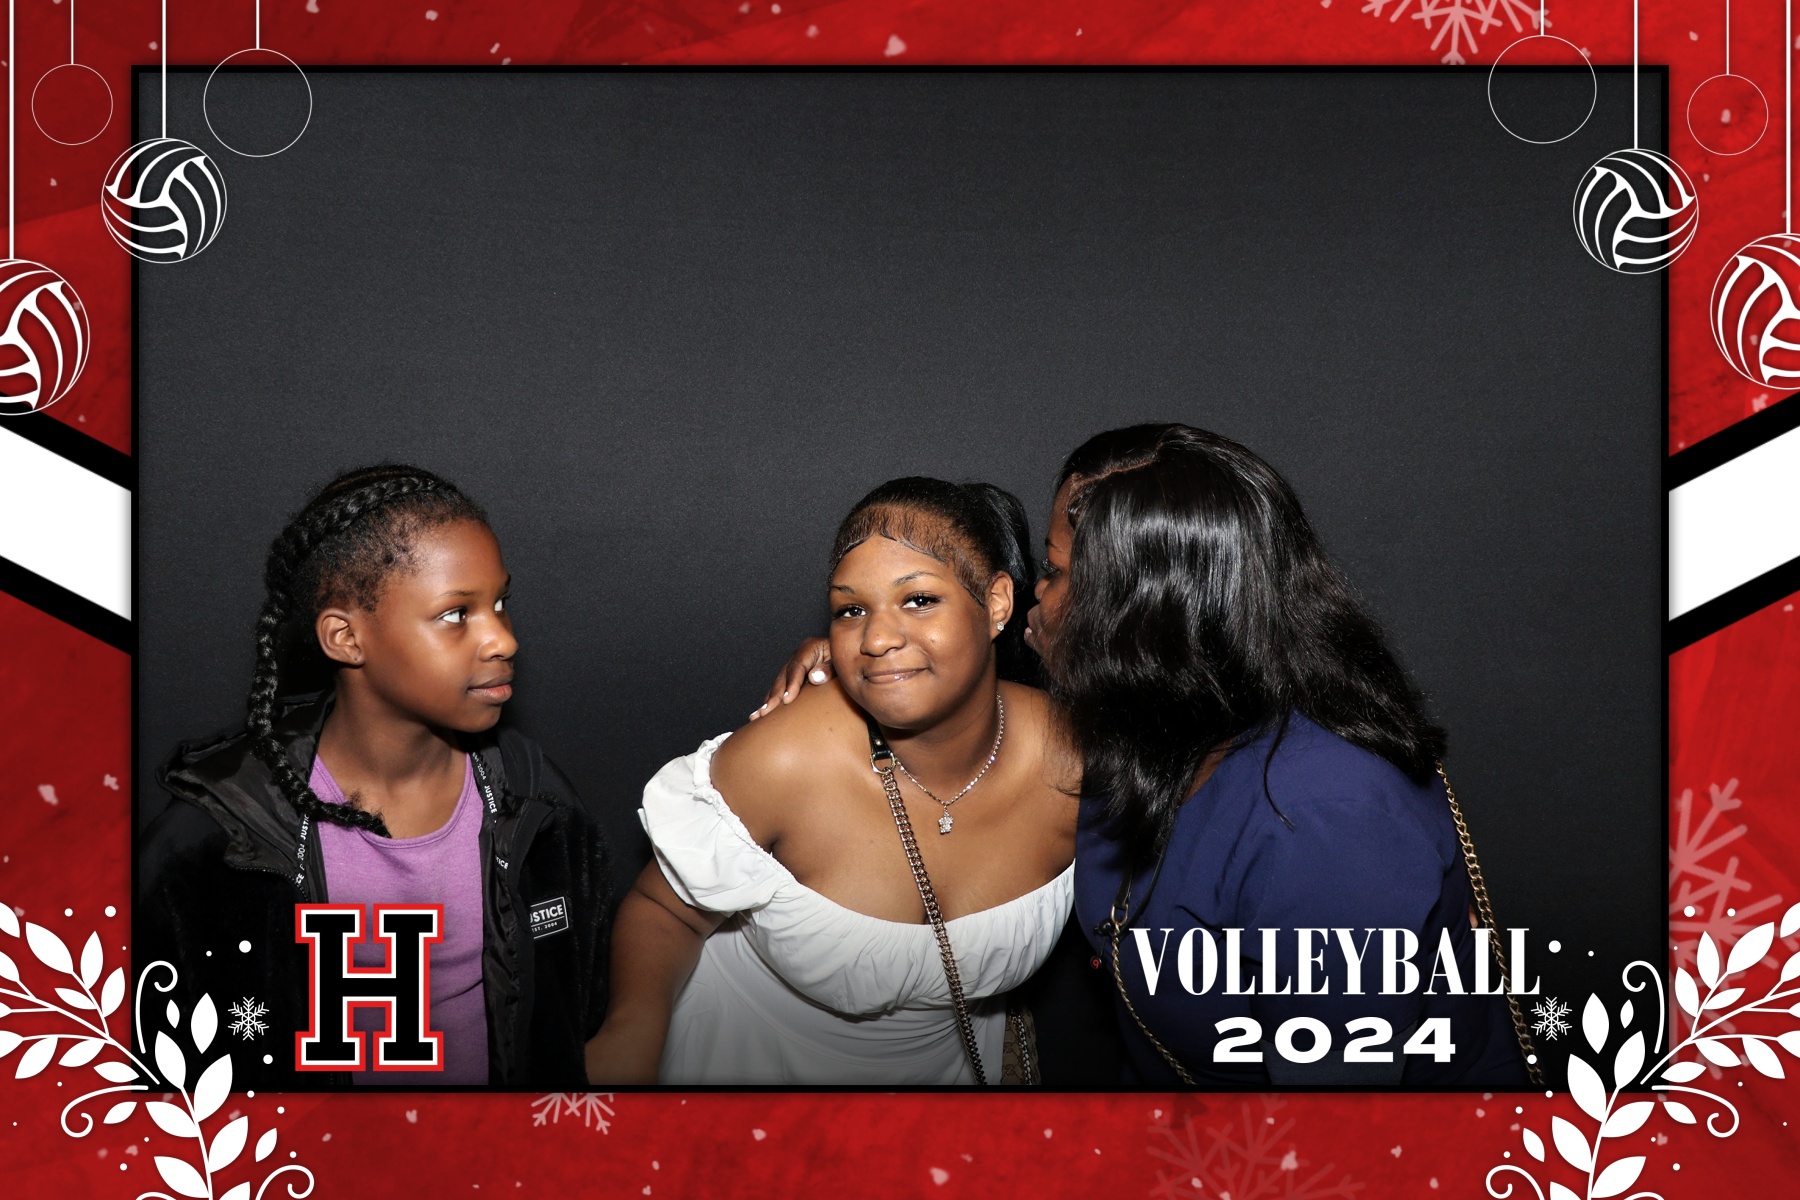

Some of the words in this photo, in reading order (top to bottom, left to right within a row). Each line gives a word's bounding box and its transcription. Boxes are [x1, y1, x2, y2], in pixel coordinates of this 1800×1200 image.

[484, 785, 498, 814] JUSTICE
[300, 813, 310, 840] JUSTIC
[530, 904, 564, 923] STICE
